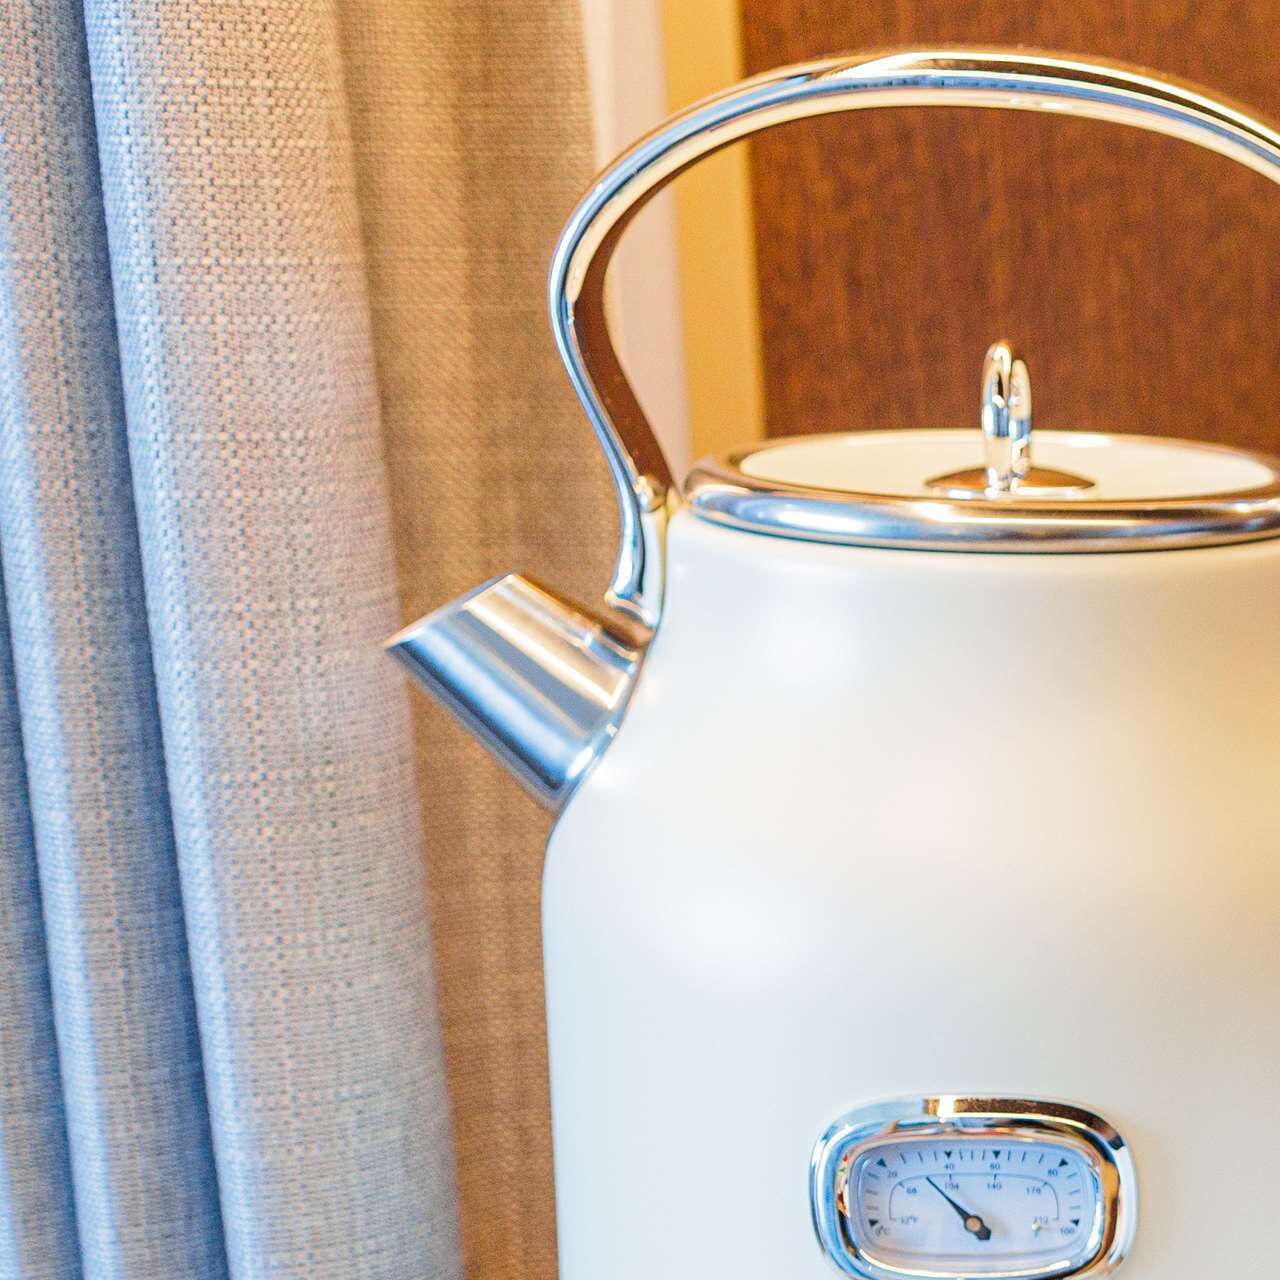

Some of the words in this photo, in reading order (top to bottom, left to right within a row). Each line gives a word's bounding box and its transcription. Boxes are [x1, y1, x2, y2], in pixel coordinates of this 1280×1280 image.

[944, 1162, 955, 1171] 40
[989, 1162, 1001, 1171] 60
[987, 1182, 1003, 1191] 140
[1060, 1226, 1076, 1235] 100
